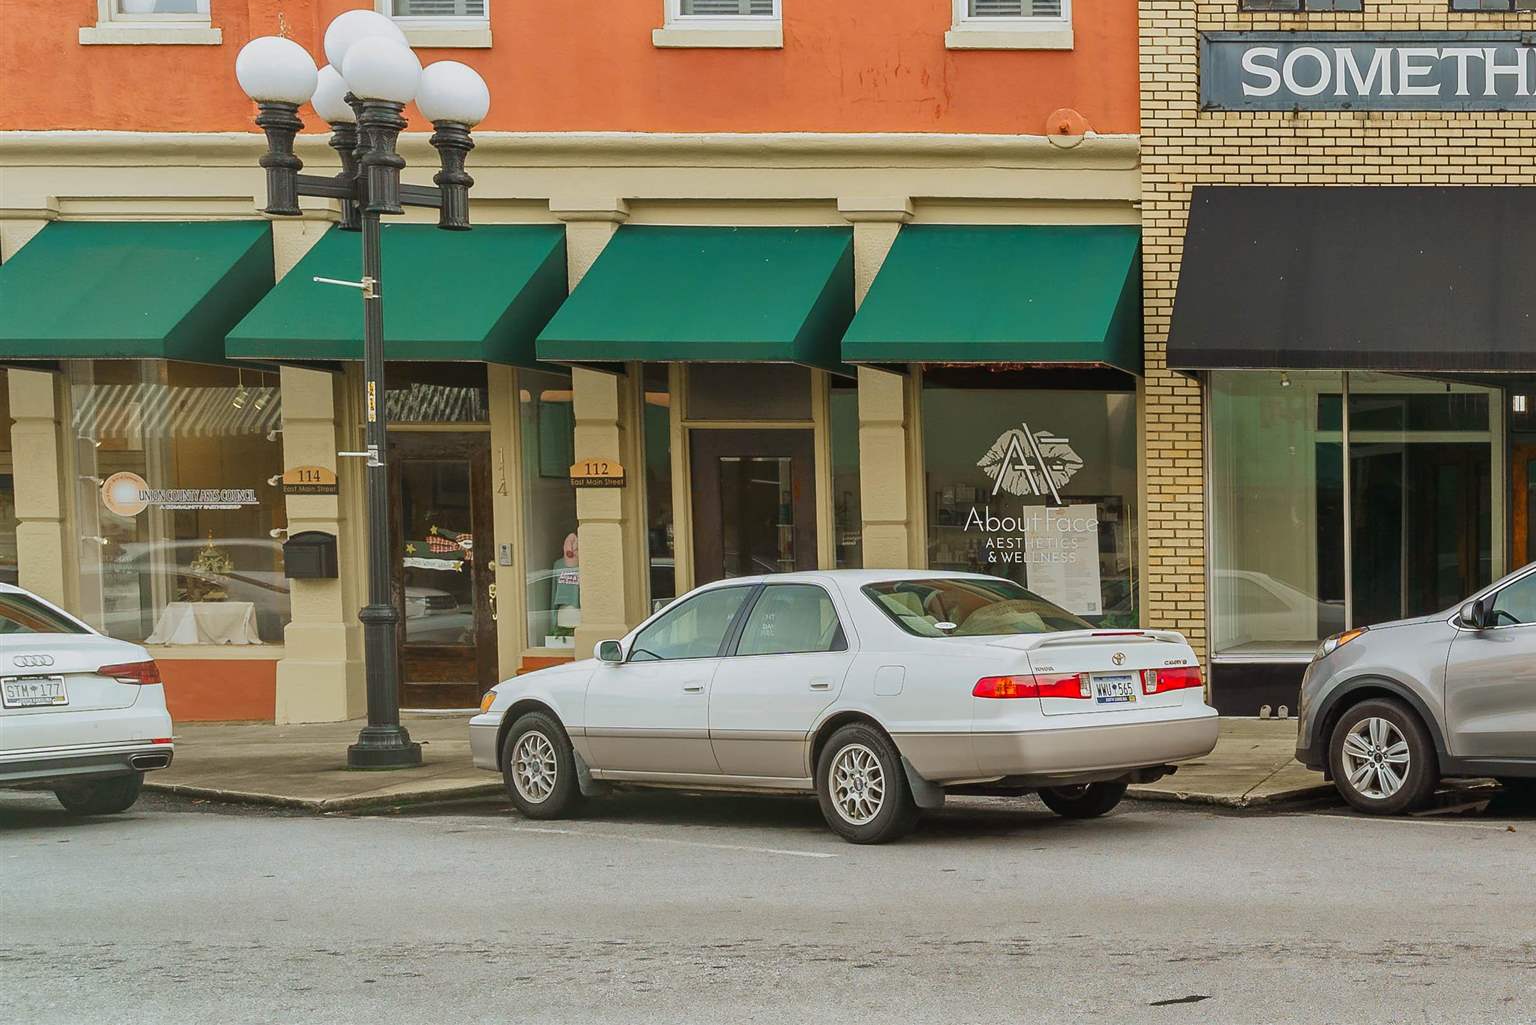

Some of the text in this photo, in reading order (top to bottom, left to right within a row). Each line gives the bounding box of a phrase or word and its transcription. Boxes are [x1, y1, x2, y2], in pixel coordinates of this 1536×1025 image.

[584, 462, 609, 475] 112
[298, 470, 320, 482] 114
[138, 489, 165, 501] UNION
[165, 489, 199, 501] COUNTY
[220, 489, 257, 501] COUNCIL
[964, 506, 1100, 533] About Face
[986, 537, 1079, 550] AESTHETICS
[988, 552, 1077, 563] & WELLNESS
[7, 683, 60, 697] STM 177
[1118, 682, 1134, 695] 565
